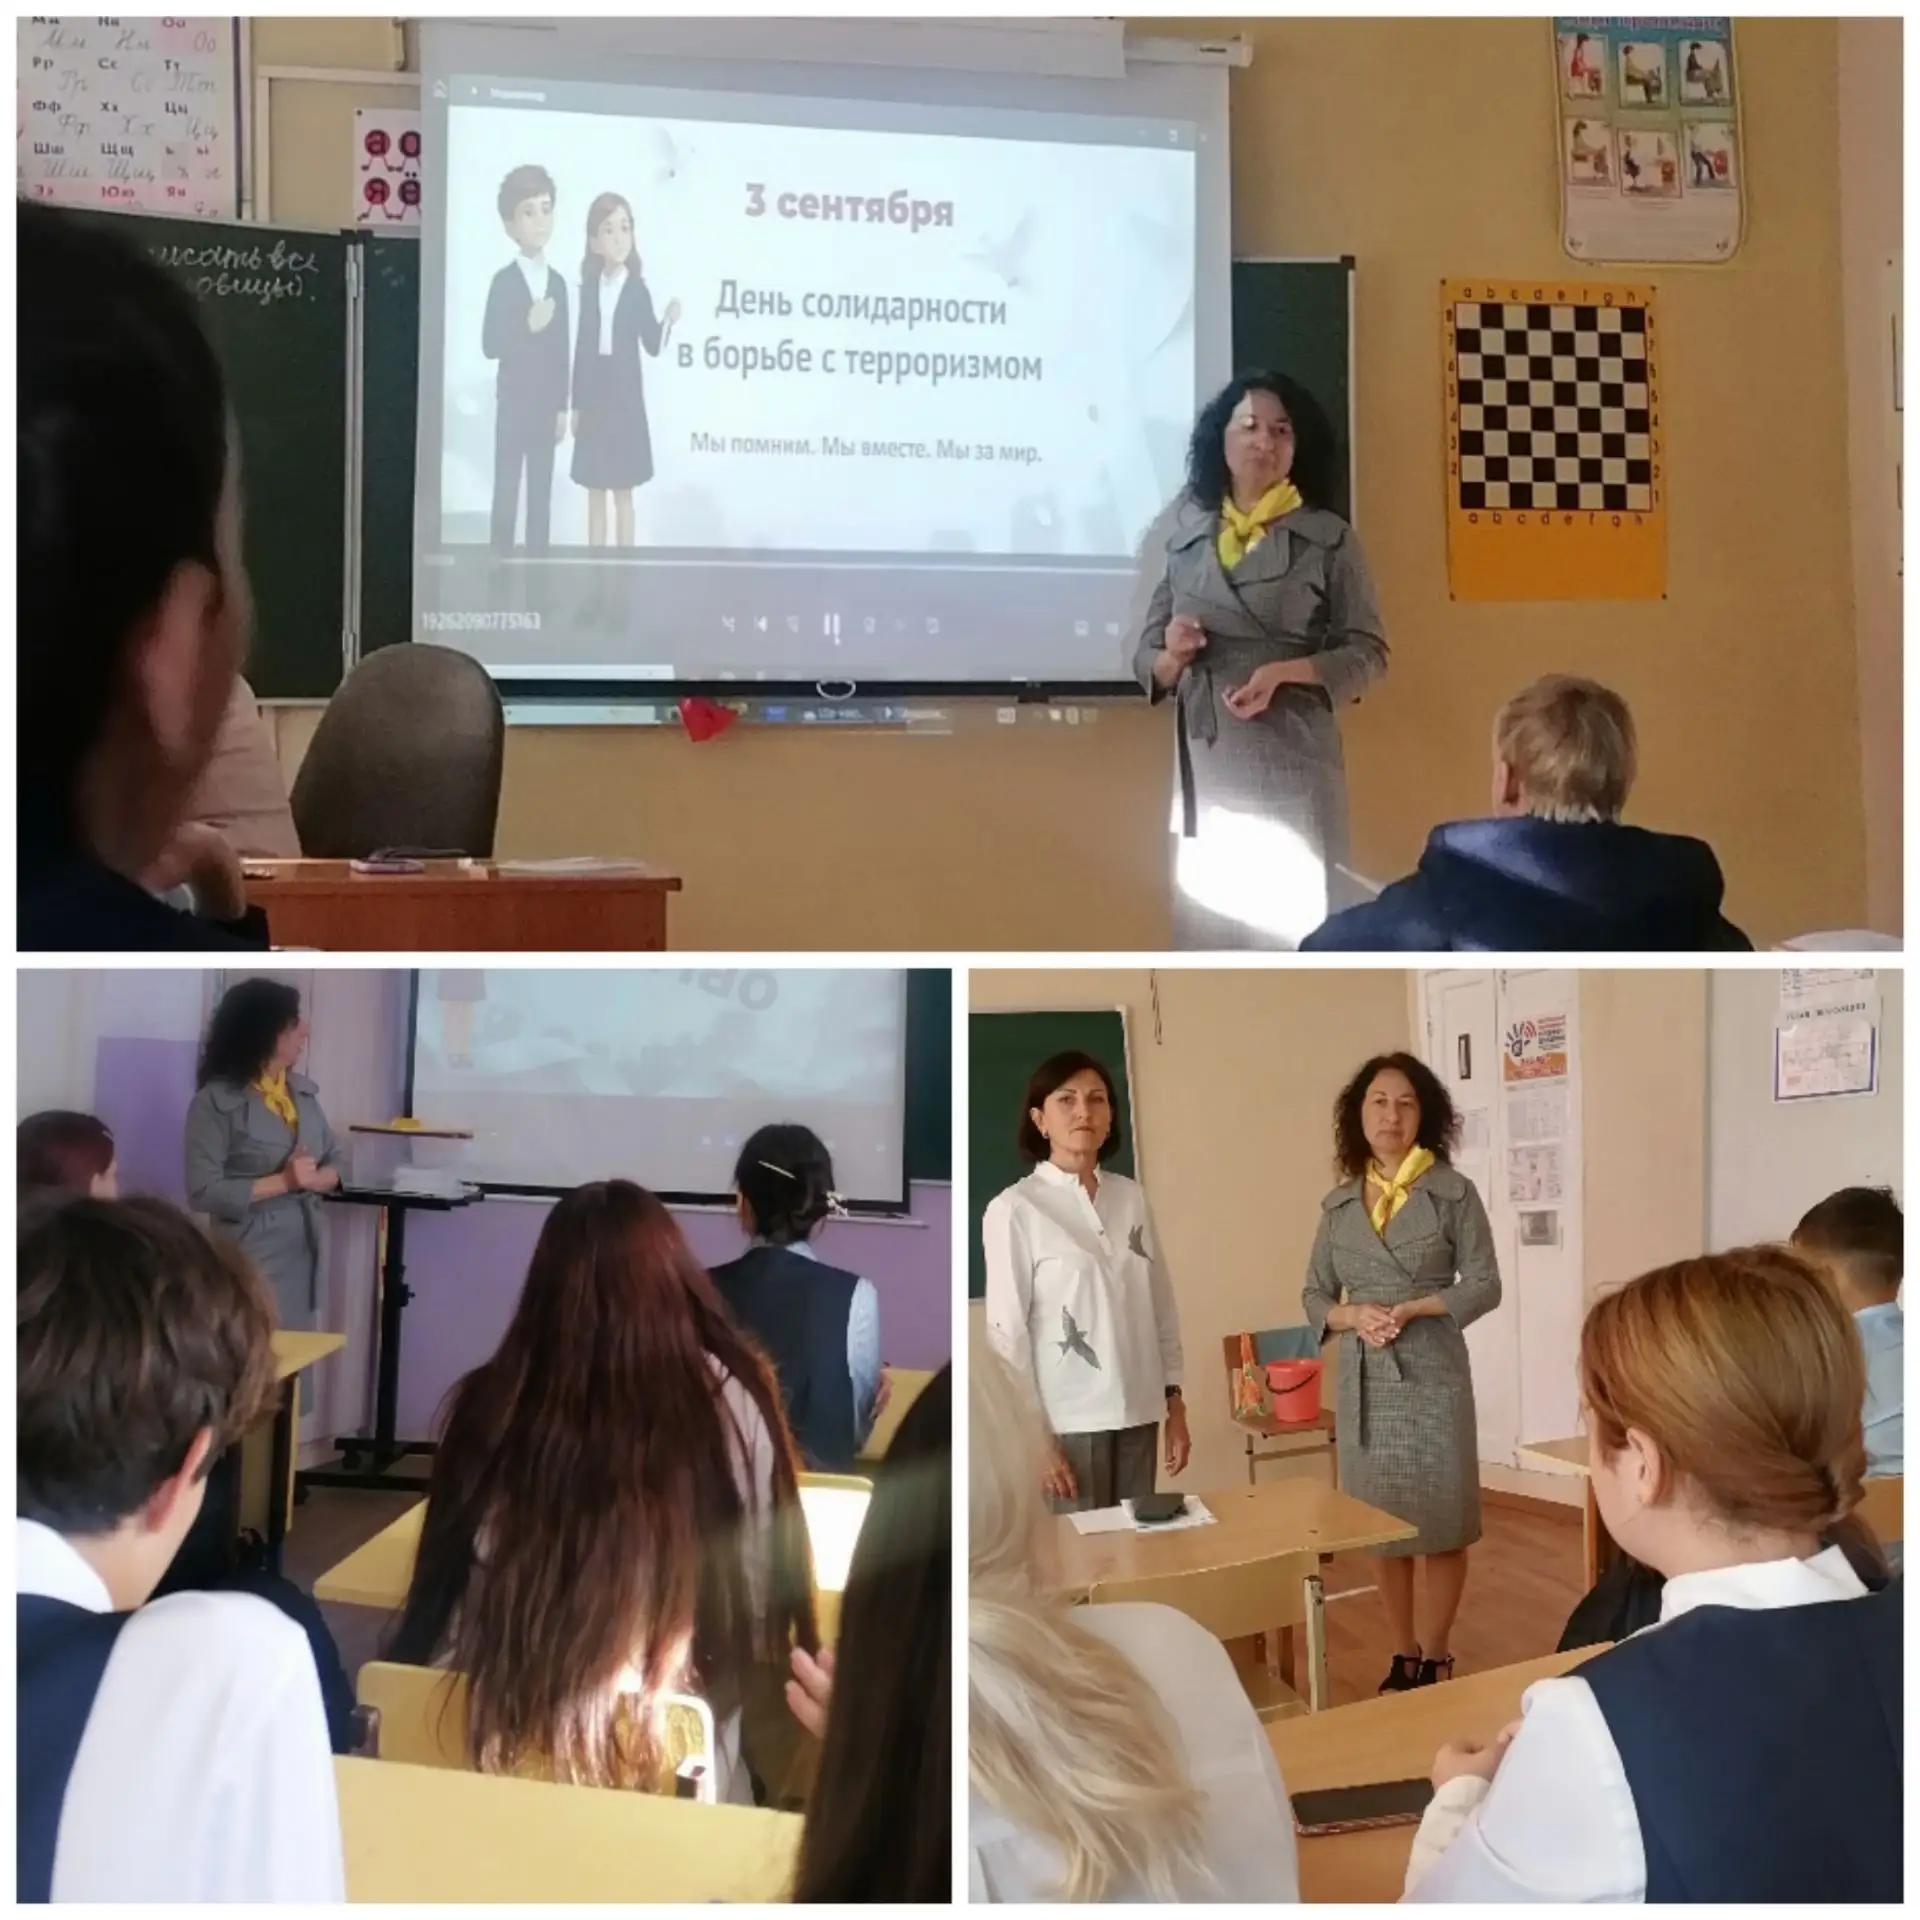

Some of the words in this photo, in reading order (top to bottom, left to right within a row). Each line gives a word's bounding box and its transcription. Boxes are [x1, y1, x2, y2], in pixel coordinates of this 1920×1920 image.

[745, 182, 765, 217] 3
[777, 189, 954, 234] сентября
[716, 279, 793, 319] День
[802, 291, 1007, 331] солидарности
[677, 343, 694, 368] в
[703, 335, 813, 380] борьбе
[821, 349, 836, 374] с
[845, 349, 1043, 386] терроризмом
[690, 432, 726, 454] Мы
[731, 437, 816, 456] помним.
[822, 436, 855, 457] Мы
[861, 439, 931, 459] вместе.
[937, 439, 970, 461] Мы
[974, 444, 995, 462] за
[999, 445, 1043, 466] мир.
